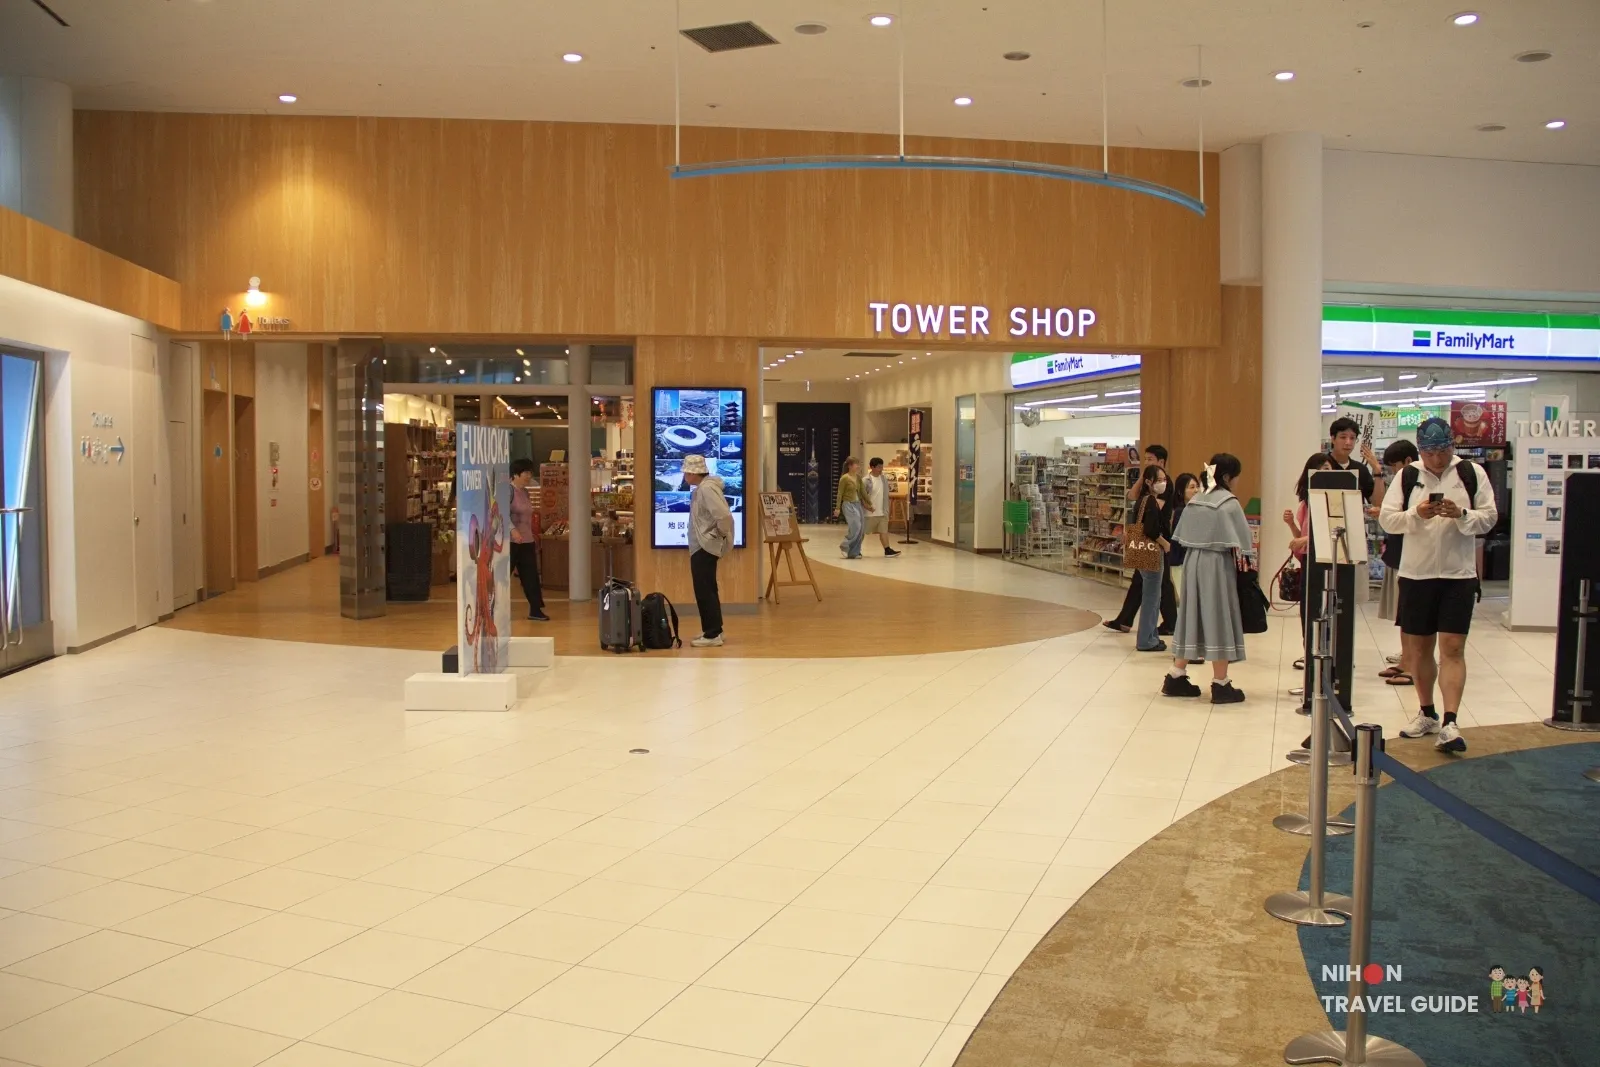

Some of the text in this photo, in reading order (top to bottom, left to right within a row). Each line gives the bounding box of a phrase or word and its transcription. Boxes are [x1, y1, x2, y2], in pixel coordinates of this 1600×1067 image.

[869, 302, 1097, 337] TOWER SHOP
[1436, 331, 1515, 350] FamilyMart
[1054, 356, 1084, 372] FamilyMart
[1516, 419, 1597, 438] TOWER
[461, 424, 510, 465] FUKUOKA
[461, 469, 482, 491] TOWER
[1128, 540, 1158, 552] A.P.C.
